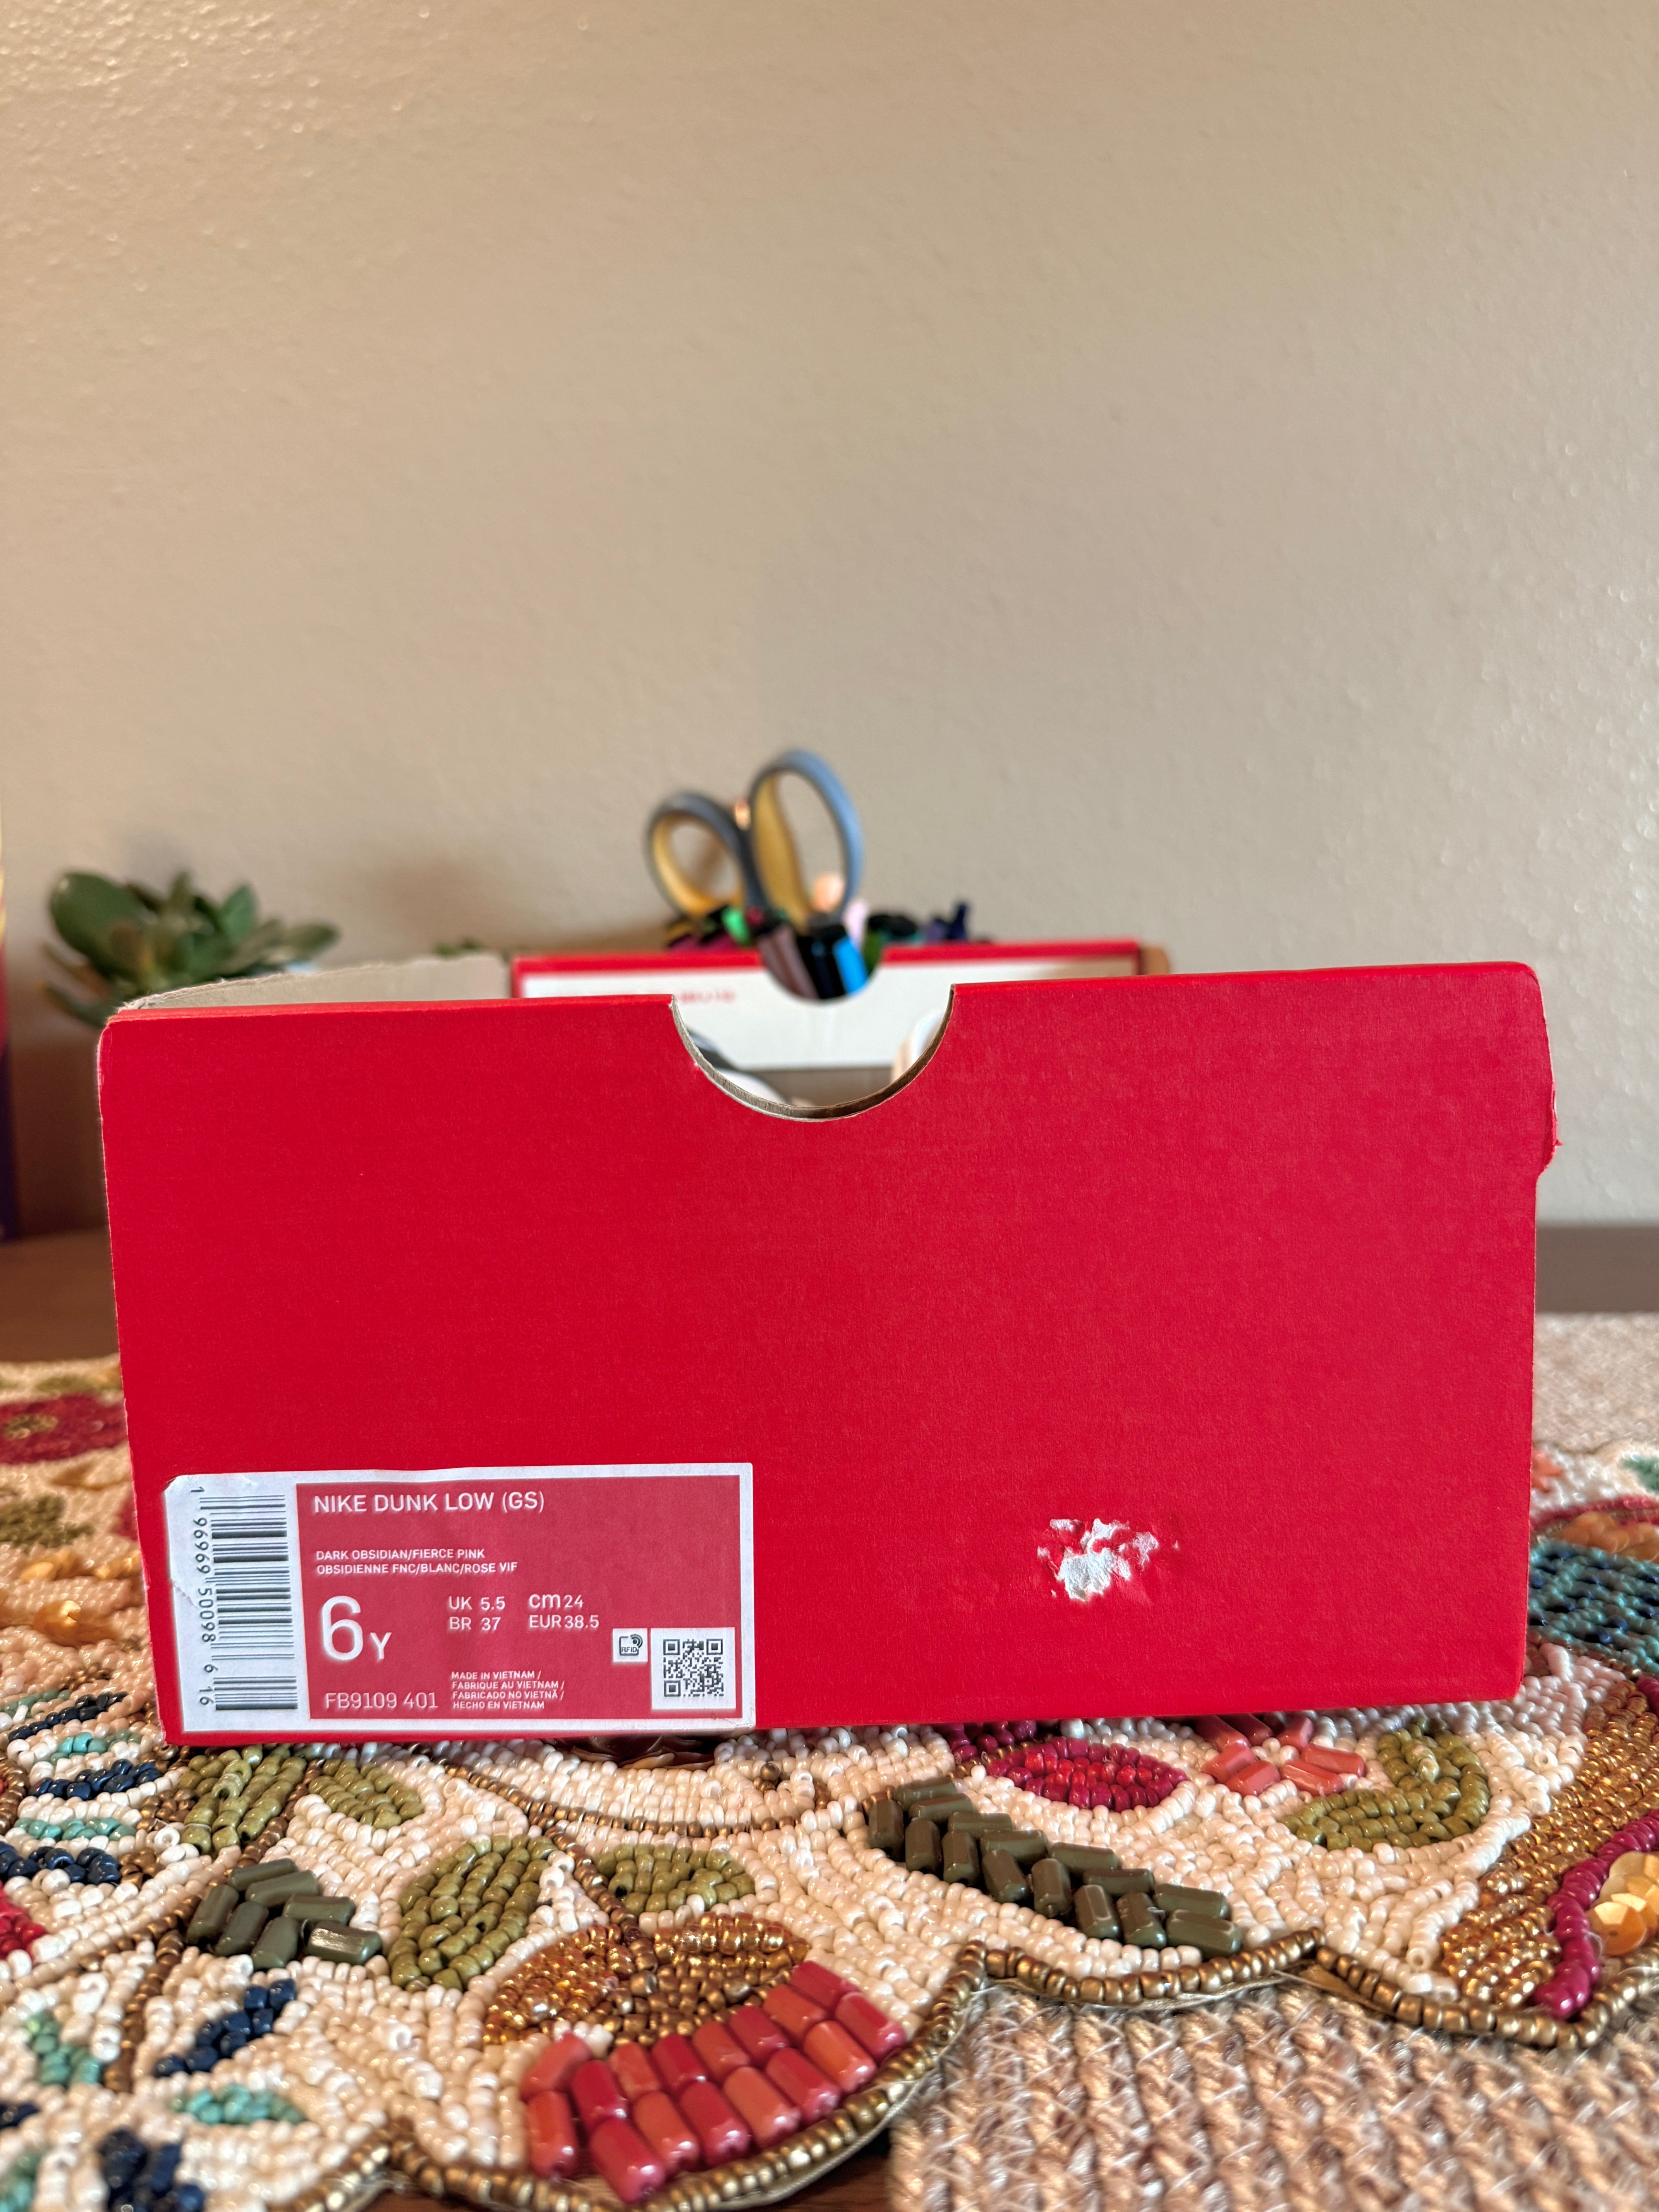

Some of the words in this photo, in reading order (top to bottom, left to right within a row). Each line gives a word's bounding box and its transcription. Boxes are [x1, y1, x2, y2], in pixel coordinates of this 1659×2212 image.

[314, 1494, 367, 1513] NIKE
[374, 1494, 438, 1511] DUNK
[445, 1492, 494, 1510] LOW
[503, 1491, 544, 1513] (GS)
[316, 1550, 349, 1561] DARK
[352, 1549, 454, 1561] OBSIDIAN/FIERCE
[457, 1549, 485, 1559] PINK
[317, 1563, 388, 1575] OBSIDIENNE
[392, 1562, 496, 1575] FNC/BLANC/ROSE
[500, 1562, 518, 1572] VIF
[448, 1596, 472, 1610] UK
[480, 1596, 505, 1610] 5.5
[449, 1616, 472, 1630] BR
[481, 1617, 501, 1630] 37
[493, 1671, 535, 1679] VIETNAM
[524, 1689, 558, 1698] VIETNÃ
[325, 1692, 397, 1709] FB9109
[403, 1692, 439, 1708] 401
